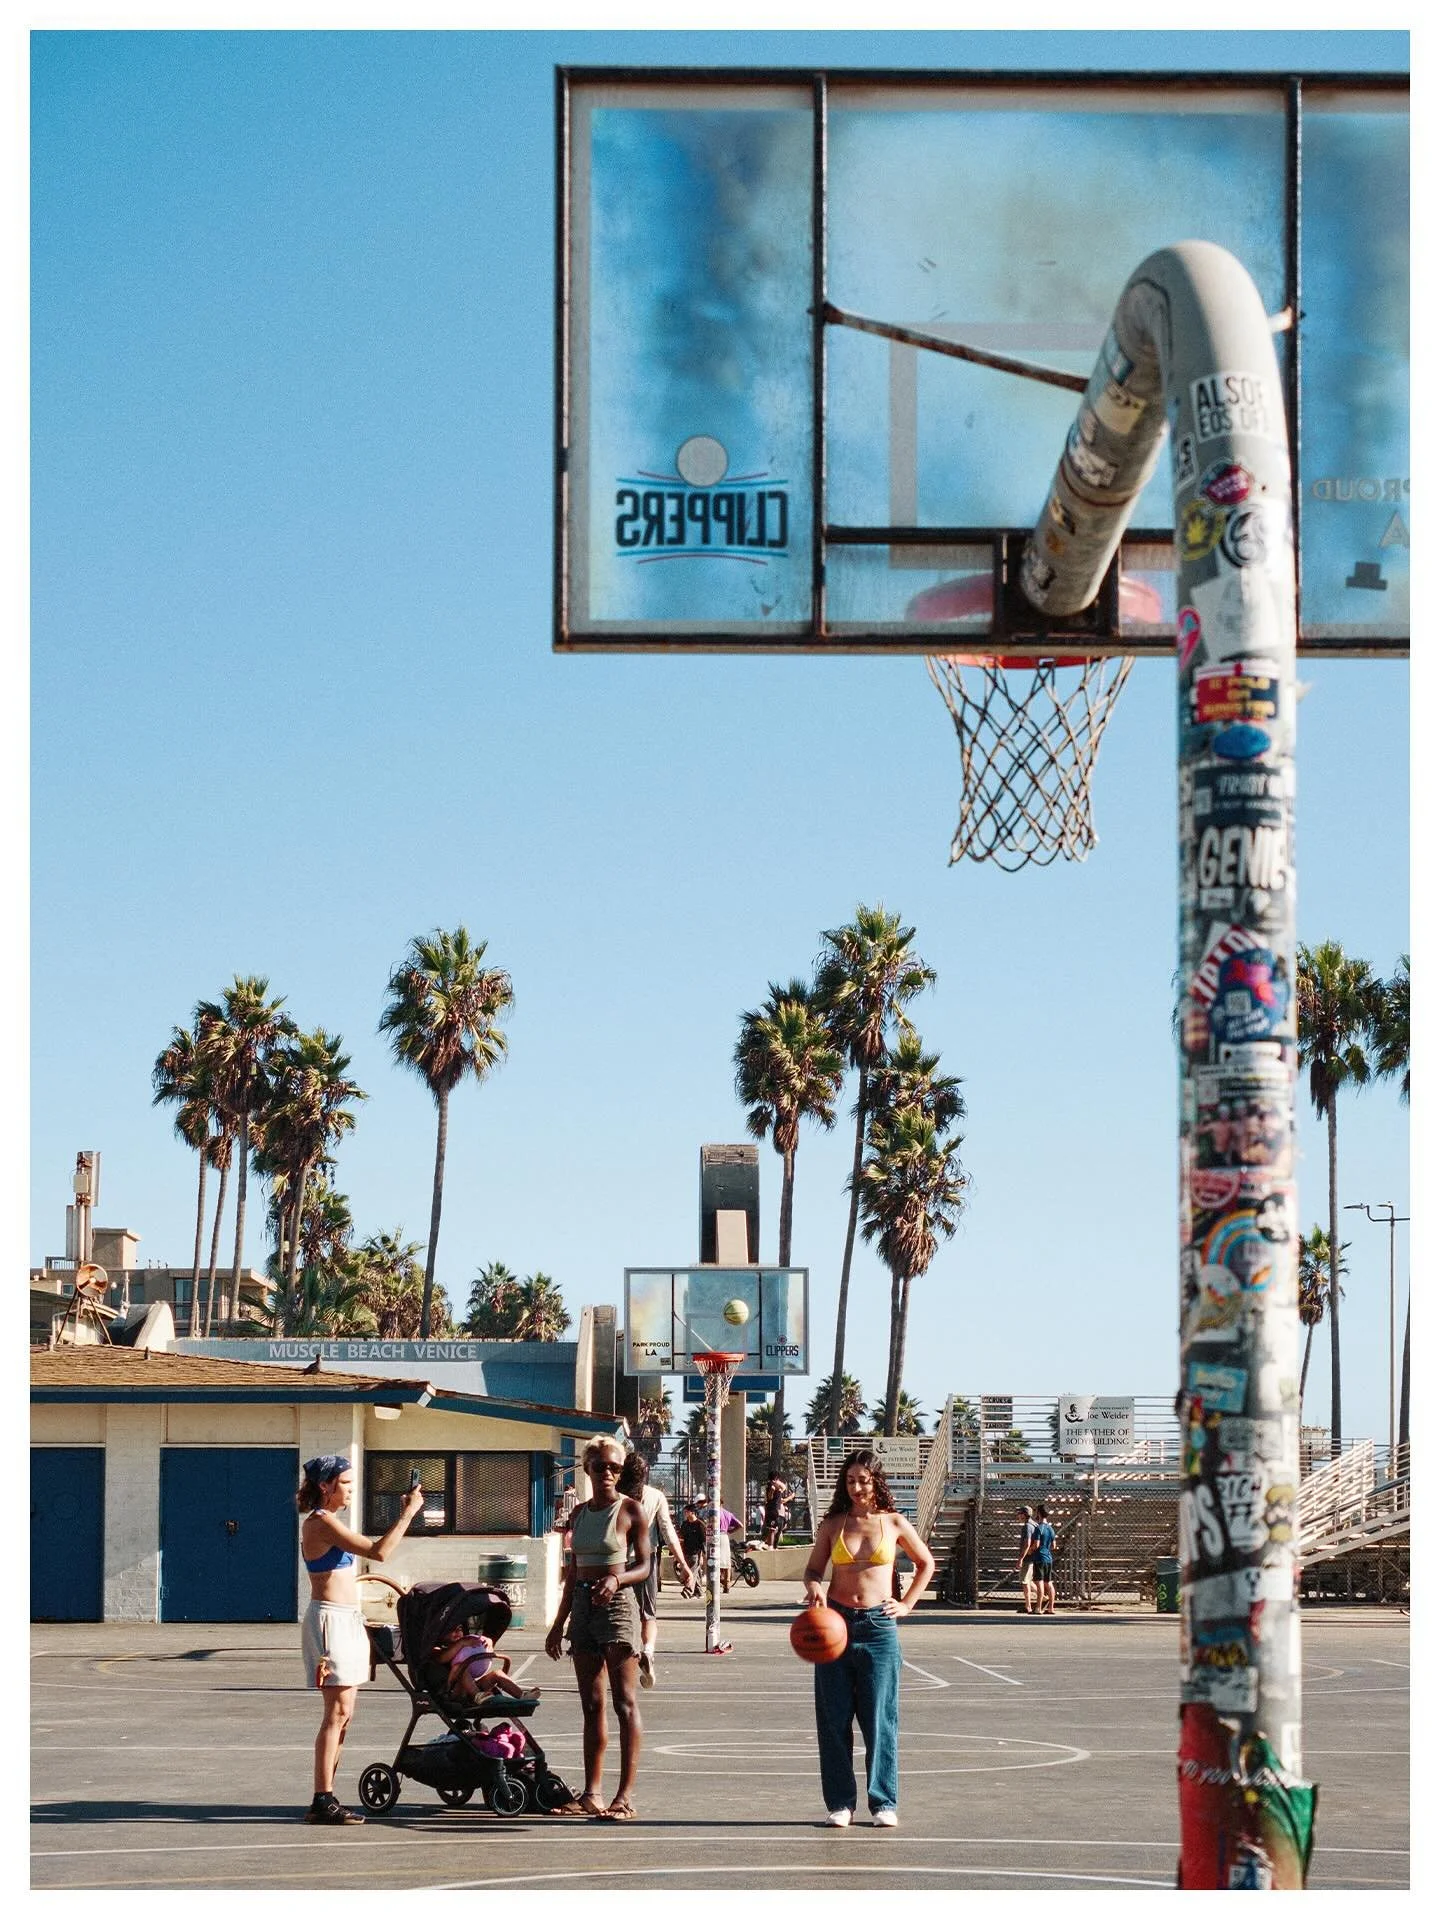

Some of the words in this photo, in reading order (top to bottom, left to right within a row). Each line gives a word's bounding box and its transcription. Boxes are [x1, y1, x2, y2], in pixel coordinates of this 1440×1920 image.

[269, 1343, 339, 1359] MUSCLE
[347, 1343, 405, 1359] BEACH
[414, 1343, 478, 1359] VENICE
[645, 1349, 657, 1357] LA
[766, 1345, 799, 1357] CLIPPERS
[1087, 1411, 1099, 1420] Joe
[1101, 1411, 1129, 1420] Weider
[1065, 1428, 1083, 1436] THE
[1085, 1428, 1116, 1436] FATHER
[1117, 1428, 1130, 1436] OF
[1065, 1437, 1129, 1446] BODYUILDING
